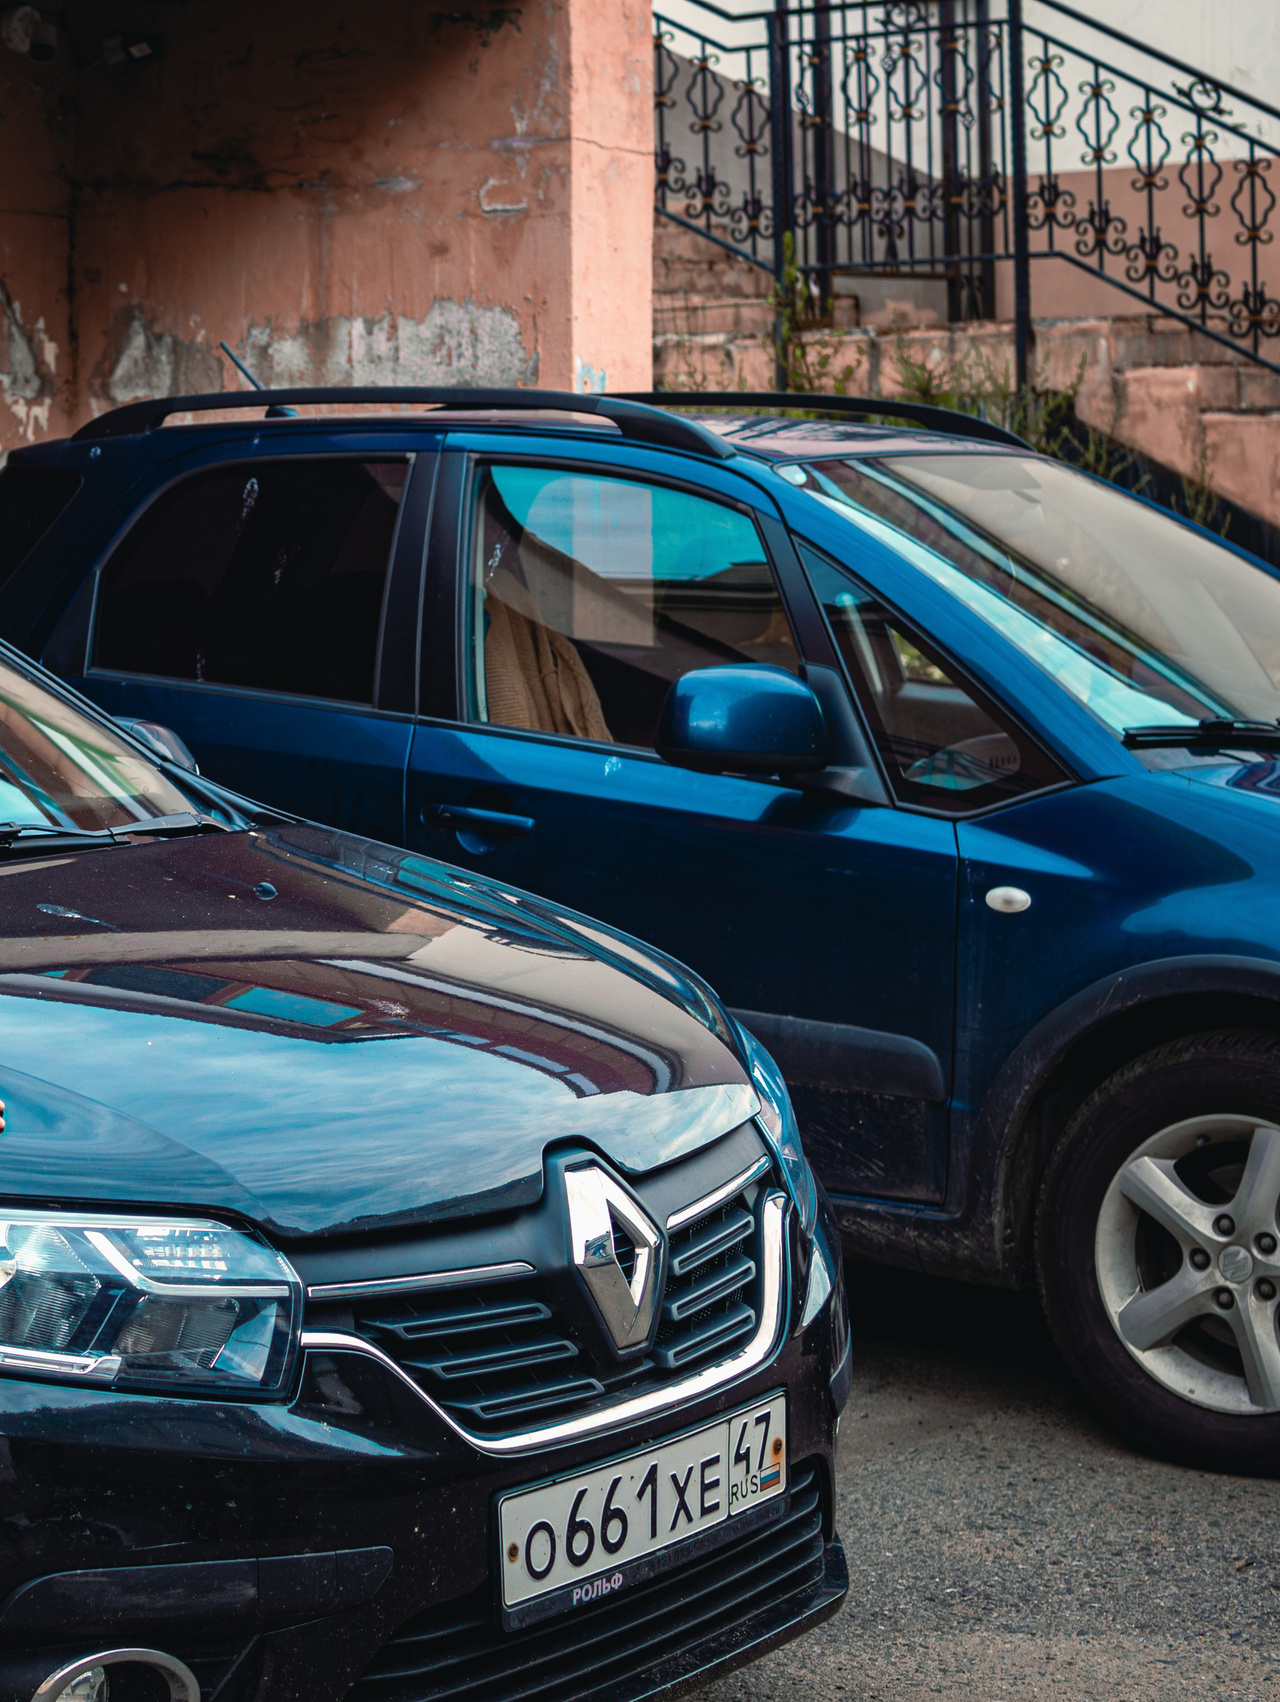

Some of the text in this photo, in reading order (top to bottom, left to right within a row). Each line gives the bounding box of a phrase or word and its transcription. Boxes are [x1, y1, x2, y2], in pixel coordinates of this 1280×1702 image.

[734, 1409, 771, 1475] 47
[730, 1474, 759, 1505] RUS
[572, 1573, 623, 1606] РОЛЬФ
